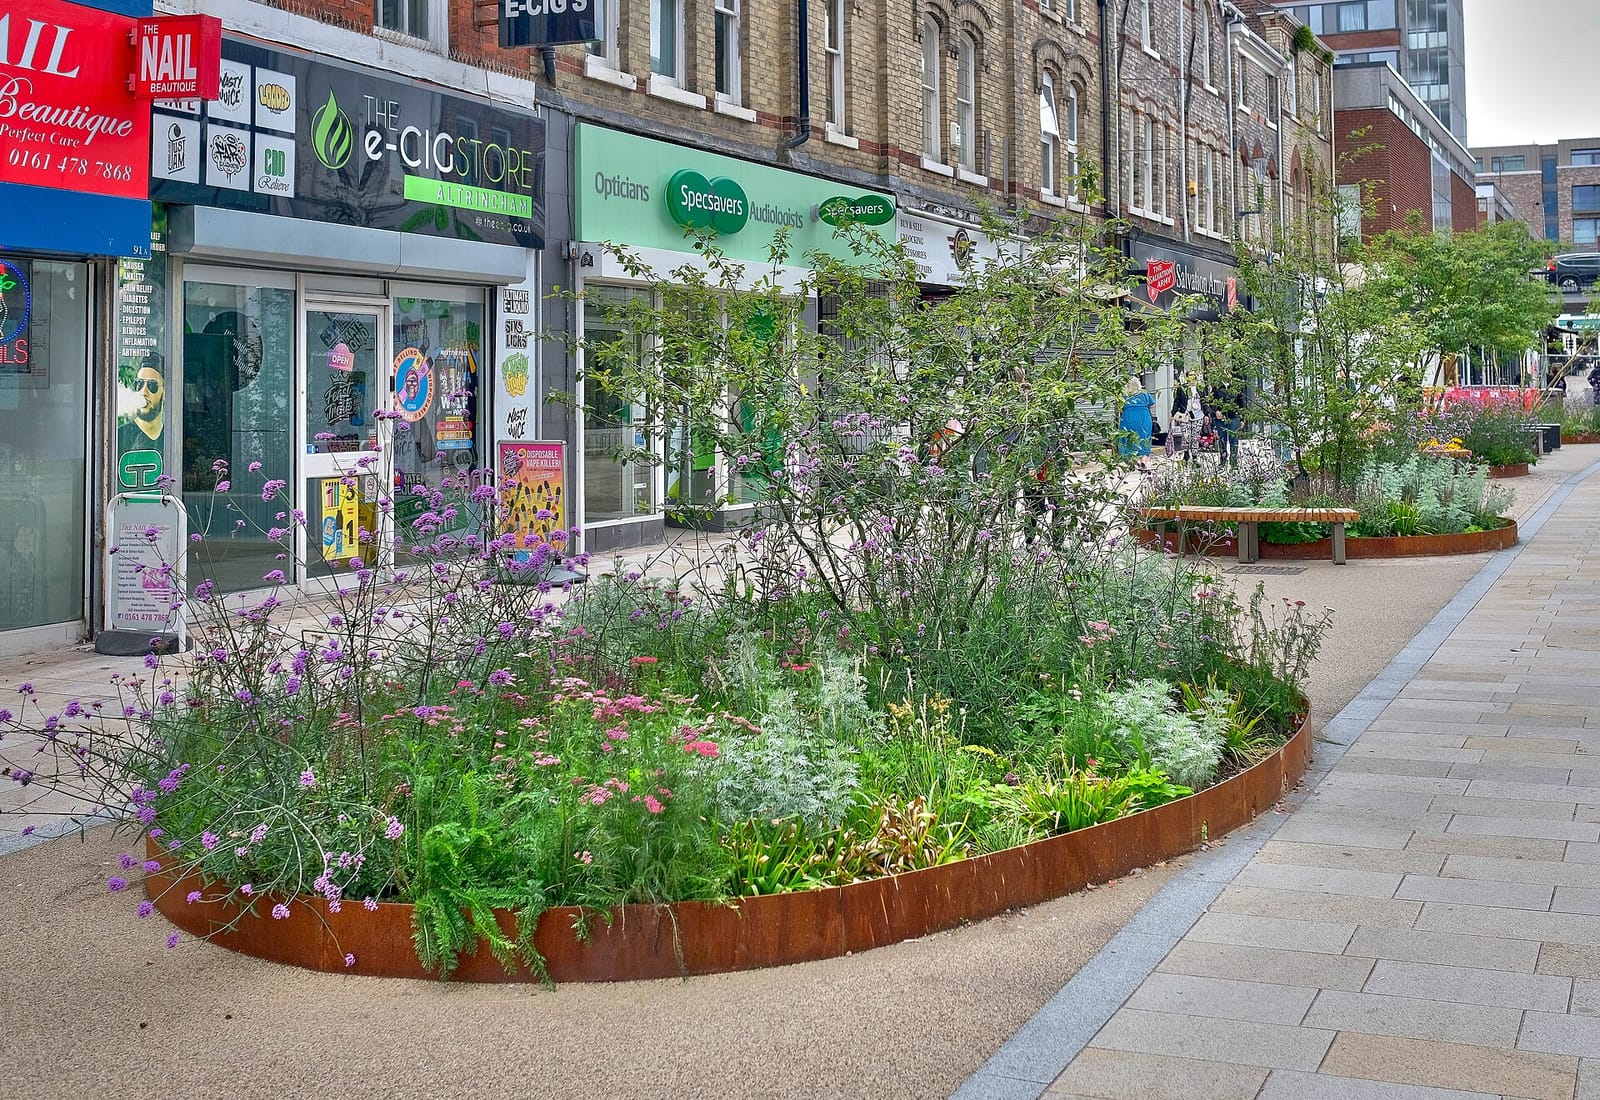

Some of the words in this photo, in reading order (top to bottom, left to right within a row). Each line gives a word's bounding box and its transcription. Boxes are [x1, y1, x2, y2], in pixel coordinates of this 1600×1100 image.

[143, 25, 159, 34] THE
[141, 34, 197, 81] NAIL
[150, 81, 196, 93] BEAUTIQUE
[0, 72, 133, 146] Beautique
[364, 95, 399, 131] THE
[0, 123, 46, 142] Perfect
[50, 131, 80, 148] Care
[9, 147, 50, 170] 0161
[57, 157, 88, 175] 478
[96, 161, 132, 181] 7868
[595, 171, 650, 204] Opticians
[438, 185, 529, 214] ALTRINGHAM
[681, 184, 743, 217] Specsavers
[750, 201, 804, 230] Audiologists
[913, 222, 922, 231] SELL
[1153, 264, 1162, 273] THE
[123, 271, 145, 281] ANXIETY
[1157, 277, 1171, 288] ARMY
[1176, 264, 1208, 294] Salvation
[1210, 272, 1226, 302] Army
[123, 295, 148, 304] DIABETES
[123, 305, 151, 314] DIGESTION
[123, 316, 146, 325] EPILEPSY
[122, 327, 147, 336] REDUCES
[122, 348, 150, 358] ARTHRITIS
[331, 354, 349, 365] OPEN
[527, 450, 558, 459] DISPOSABLE
[527, 459, 540, 467] VAPE
